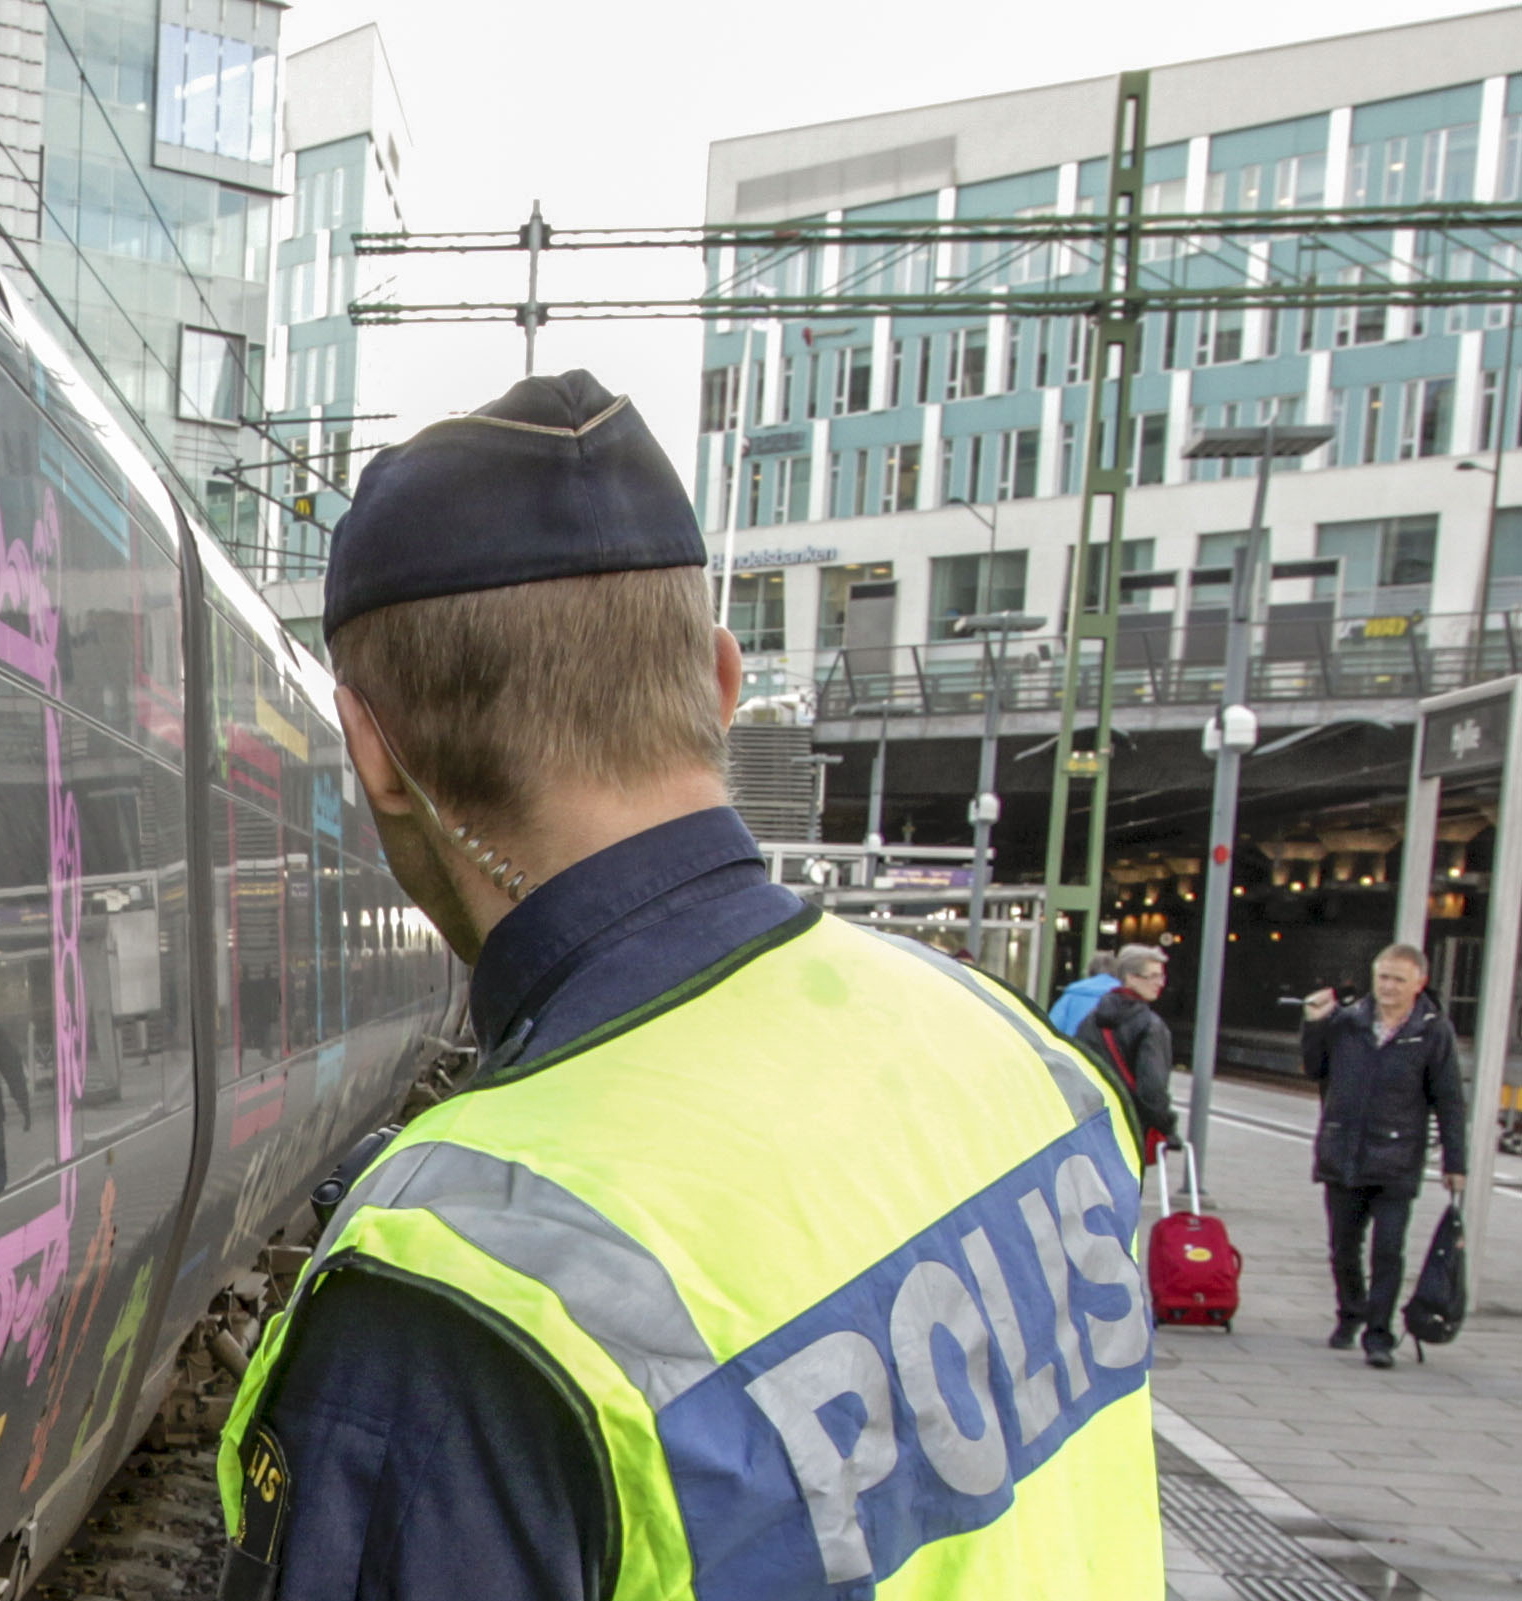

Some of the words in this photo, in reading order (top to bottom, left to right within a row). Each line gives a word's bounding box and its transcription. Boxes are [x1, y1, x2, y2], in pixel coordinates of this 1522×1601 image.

[712, 546, 838, 570] Hndelsbanken
[744, 1154, 1148, 1584] POLIS
[247, 1444, 283, 1503] LIS
